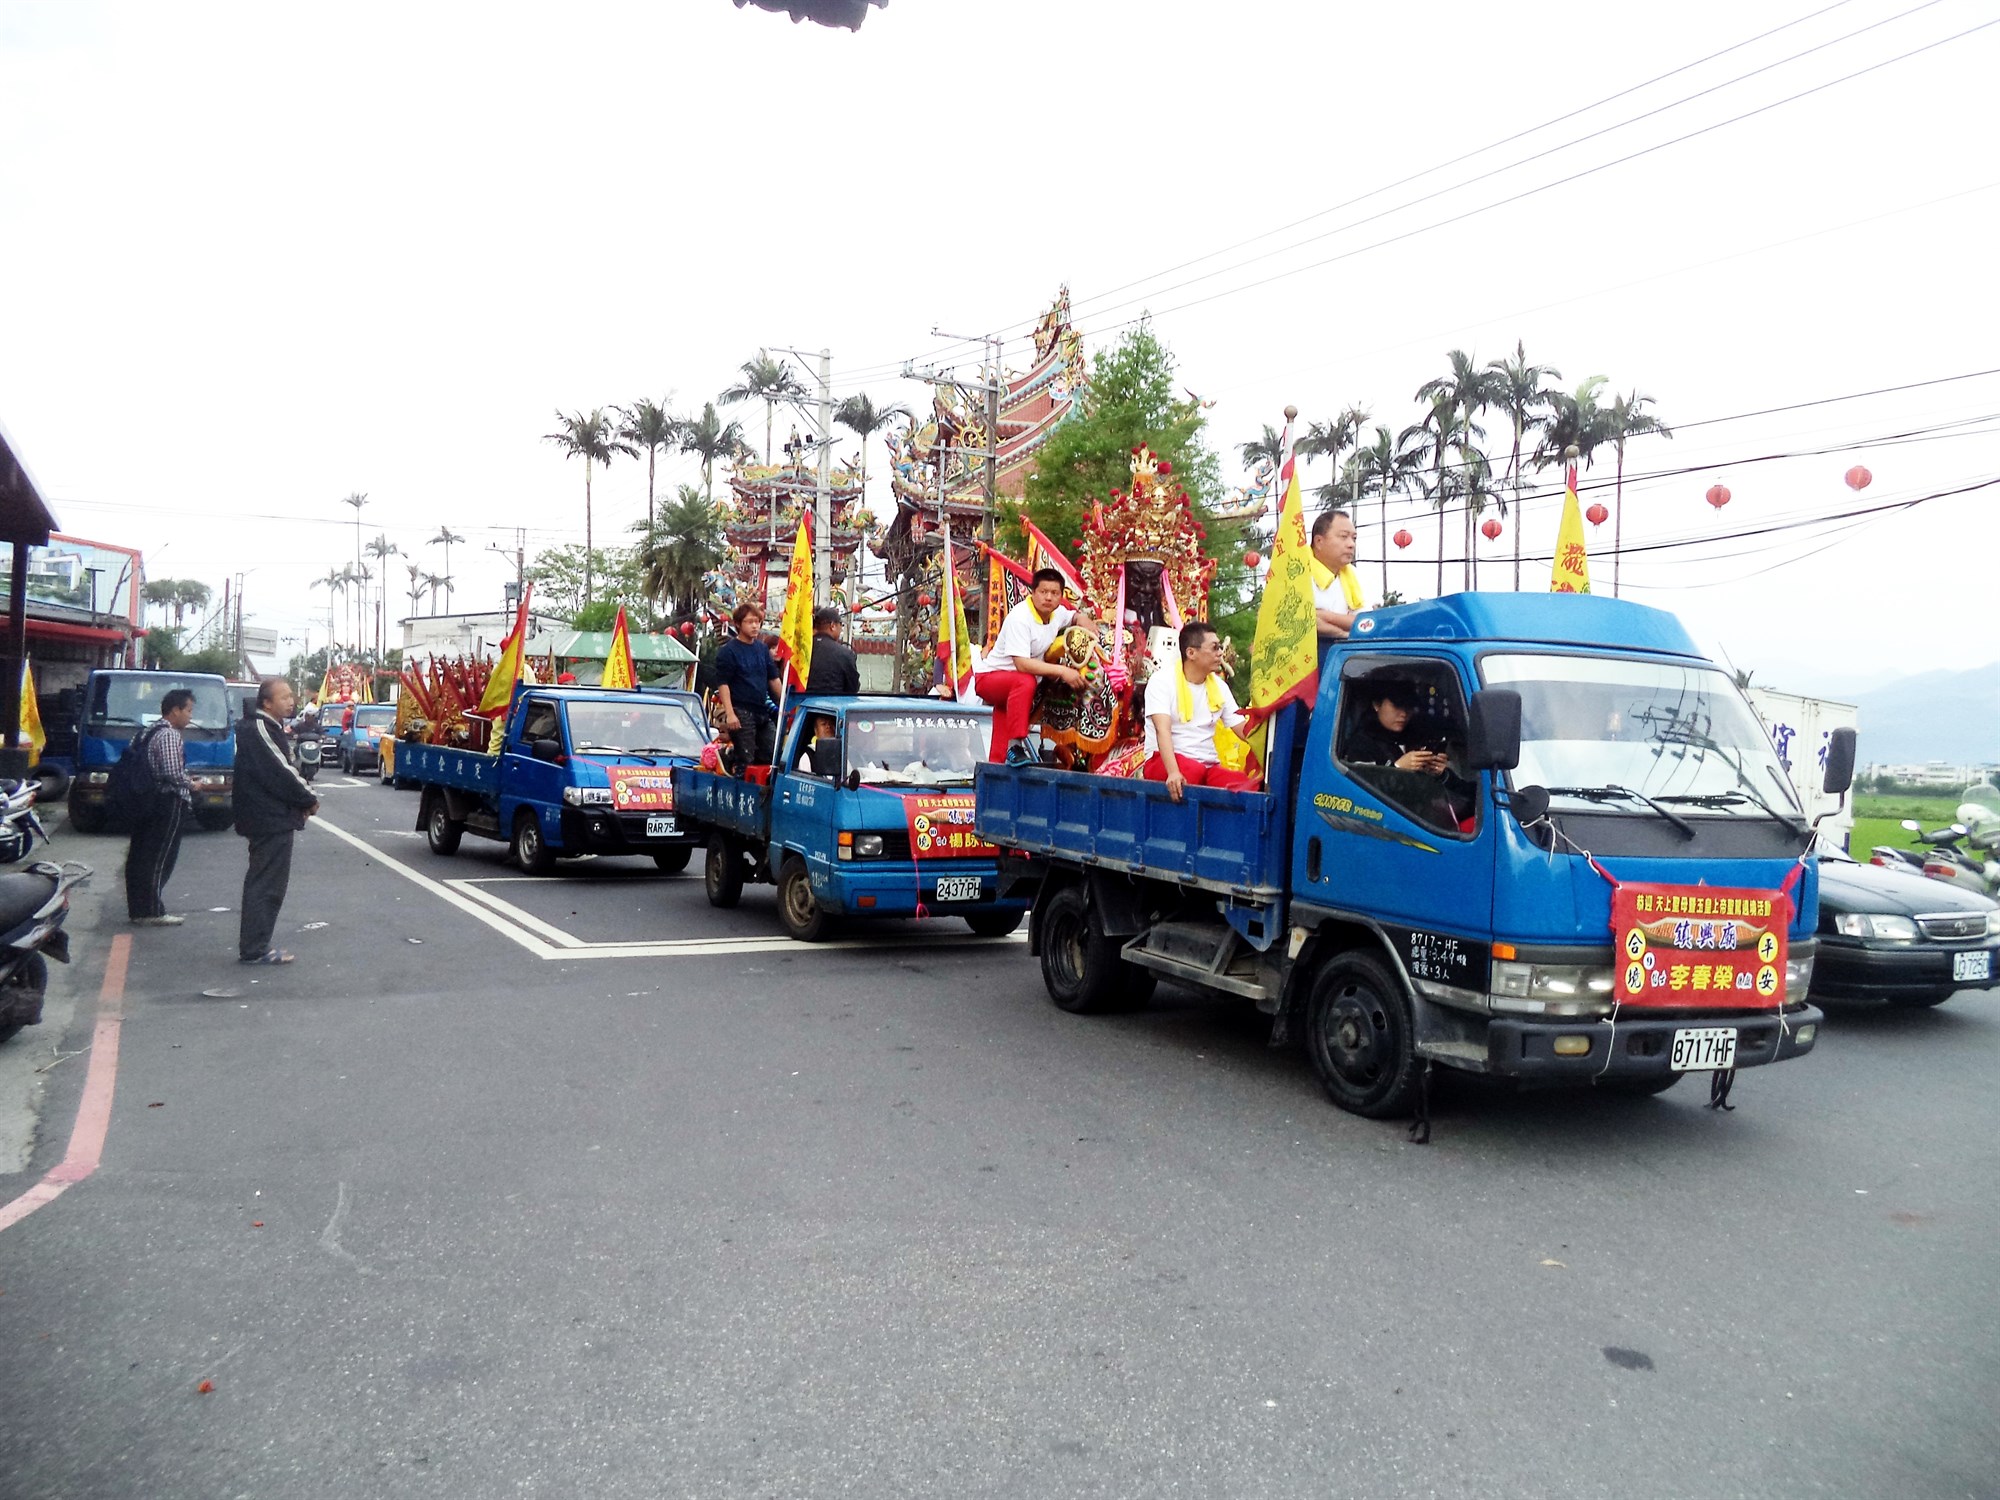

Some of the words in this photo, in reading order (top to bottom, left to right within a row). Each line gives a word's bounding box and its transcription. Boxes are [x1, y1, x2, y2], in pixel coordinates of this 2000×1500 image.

[1410, 932, 1459, 952] 8717-HF
[1674, 919, 1738, 950] 鎮興廟
[1646, 956, 1653, 966] 9
[1669, 964, 1734, 990] 李春榮
[1673, 1037, 1735, 1064] 8717-HF
